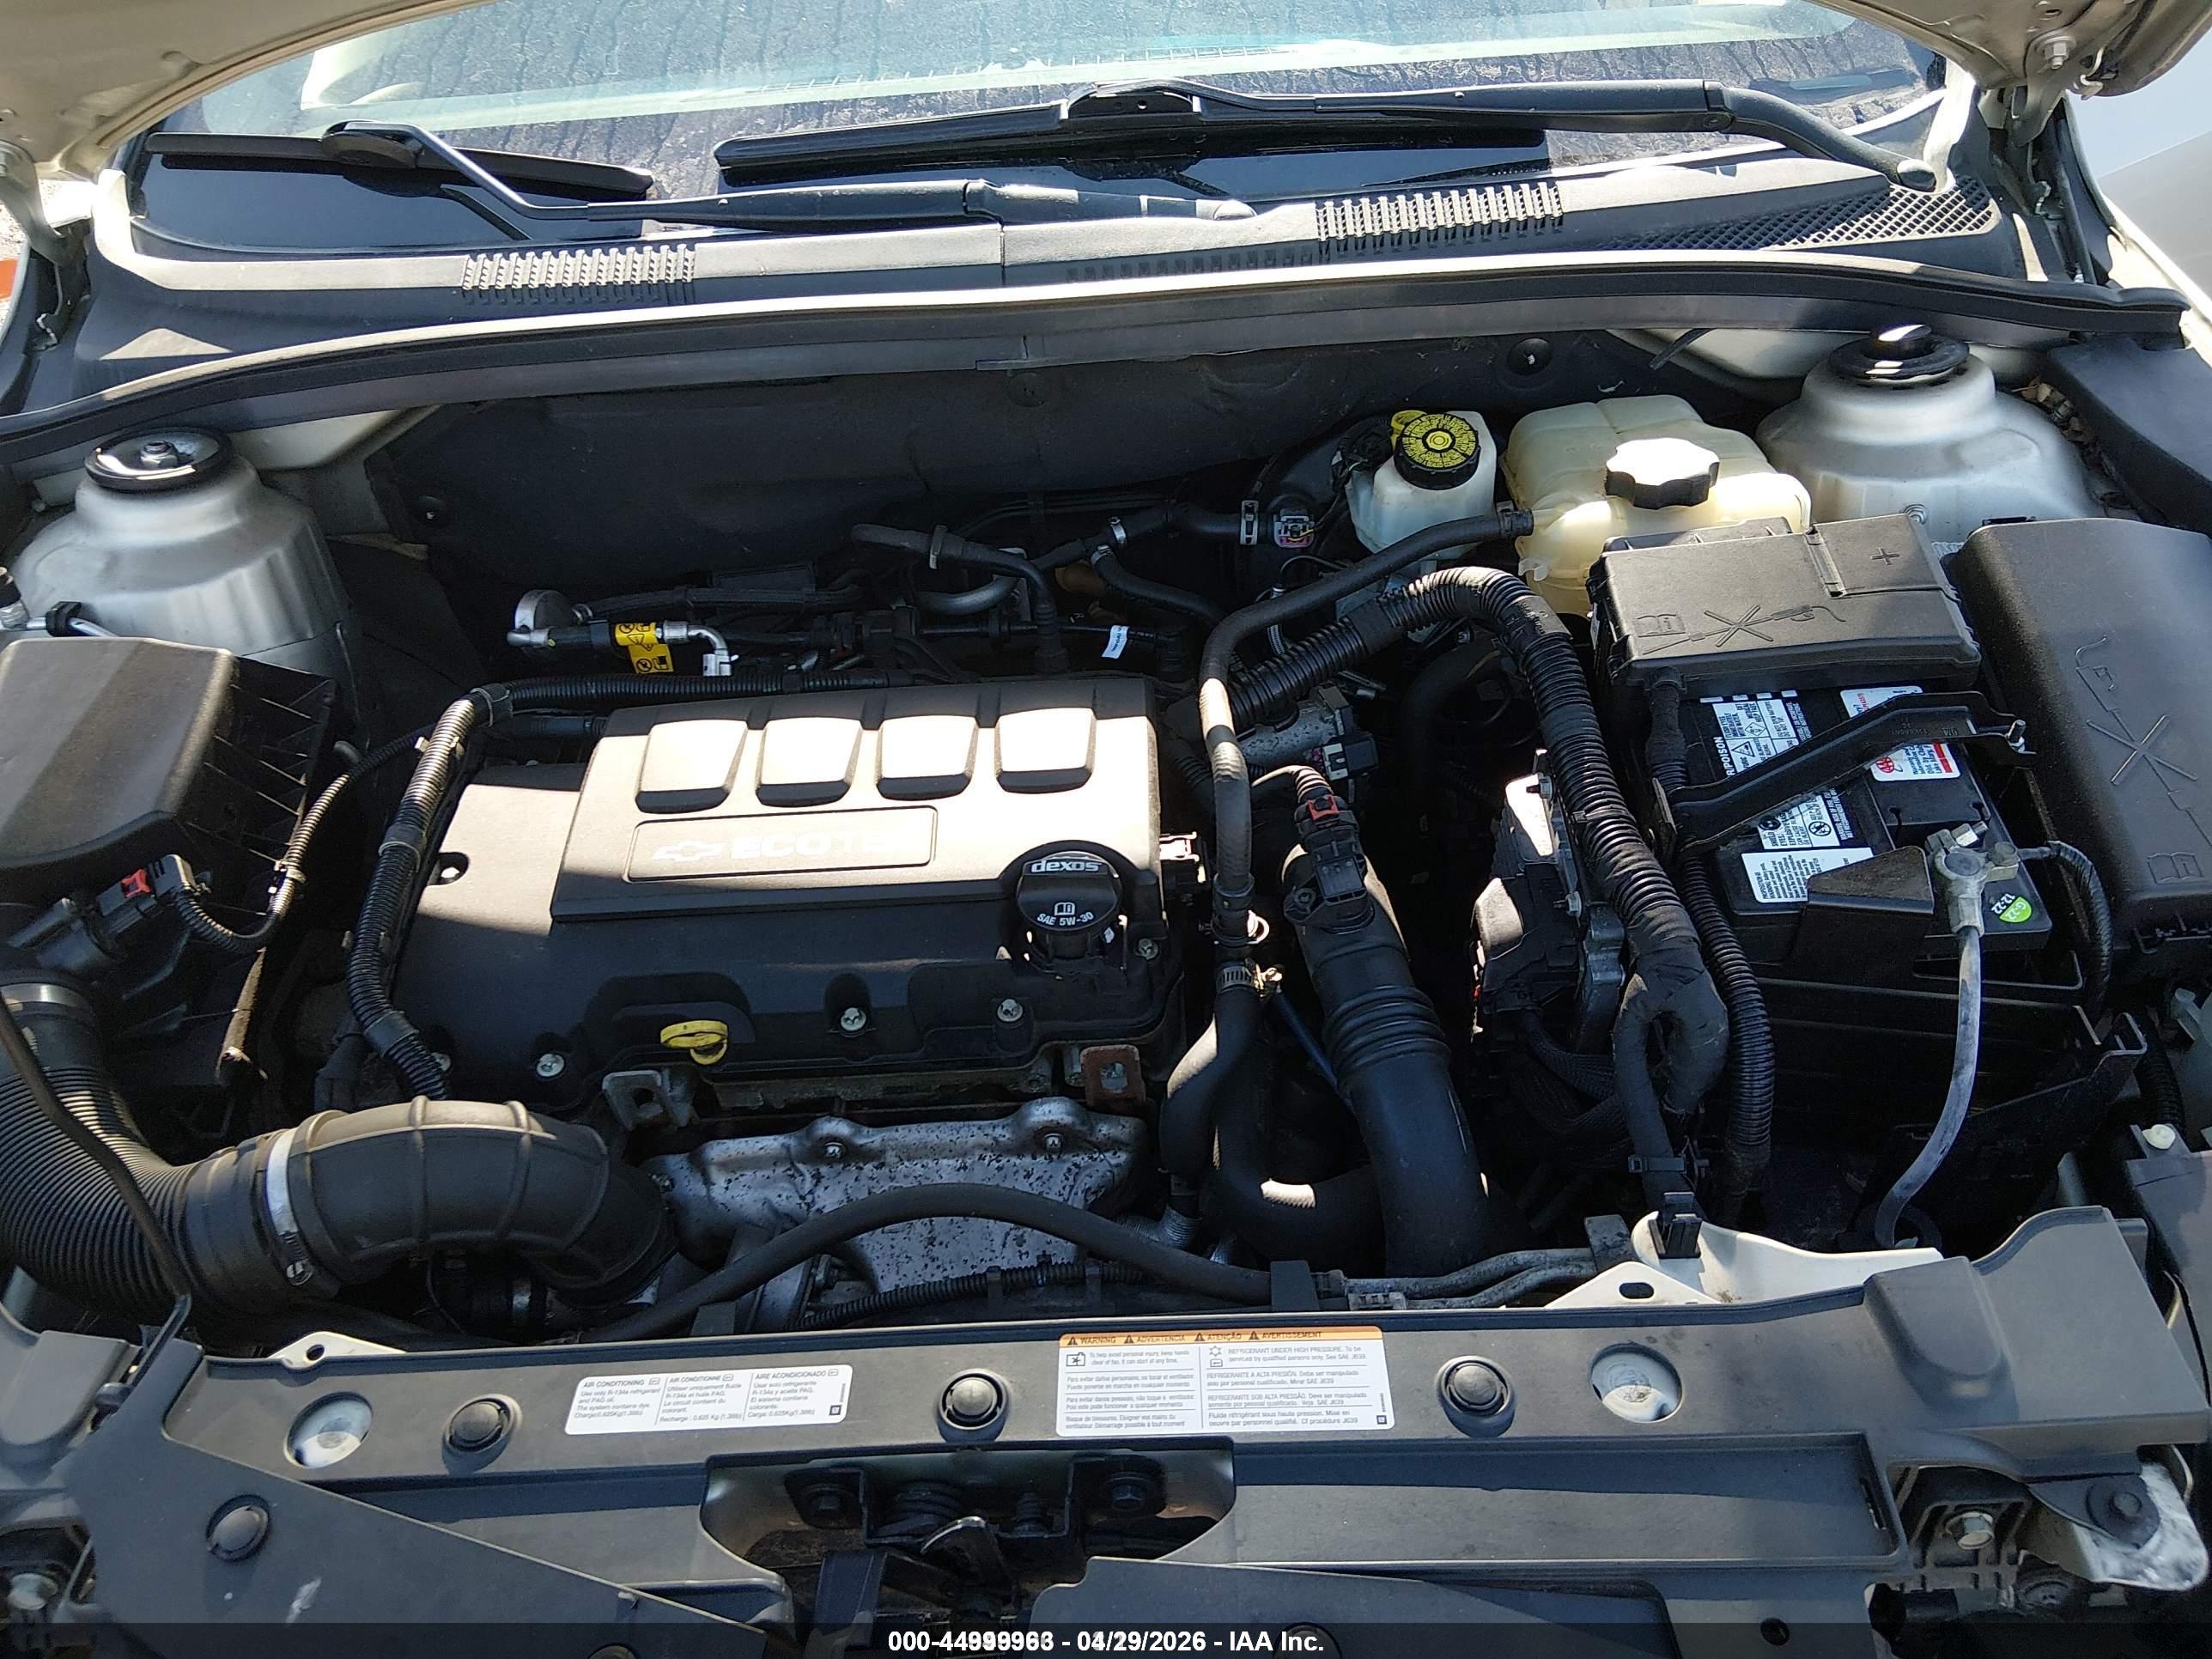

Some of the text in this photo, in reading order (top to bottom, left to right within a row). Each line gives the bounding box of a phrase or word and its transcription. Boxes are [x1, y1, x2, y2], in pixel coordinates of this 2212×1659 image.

[732, 830, 908, 860] ECOTE
[1031, 860, 1103, 872] dexos
[1990, 893, 2016, 915] 12-22
[1036, 912, 1094, 926] SAE 5W-30
[1208, 1332, 1242, 1340] ATENÇÃO
[1262, 1331, 1322, 1340] AVERTISSEMENT
[771, 1370, 826, 1379] ACONDICIONADO
[597, 1379, 644, 1388] CONDITIONING
